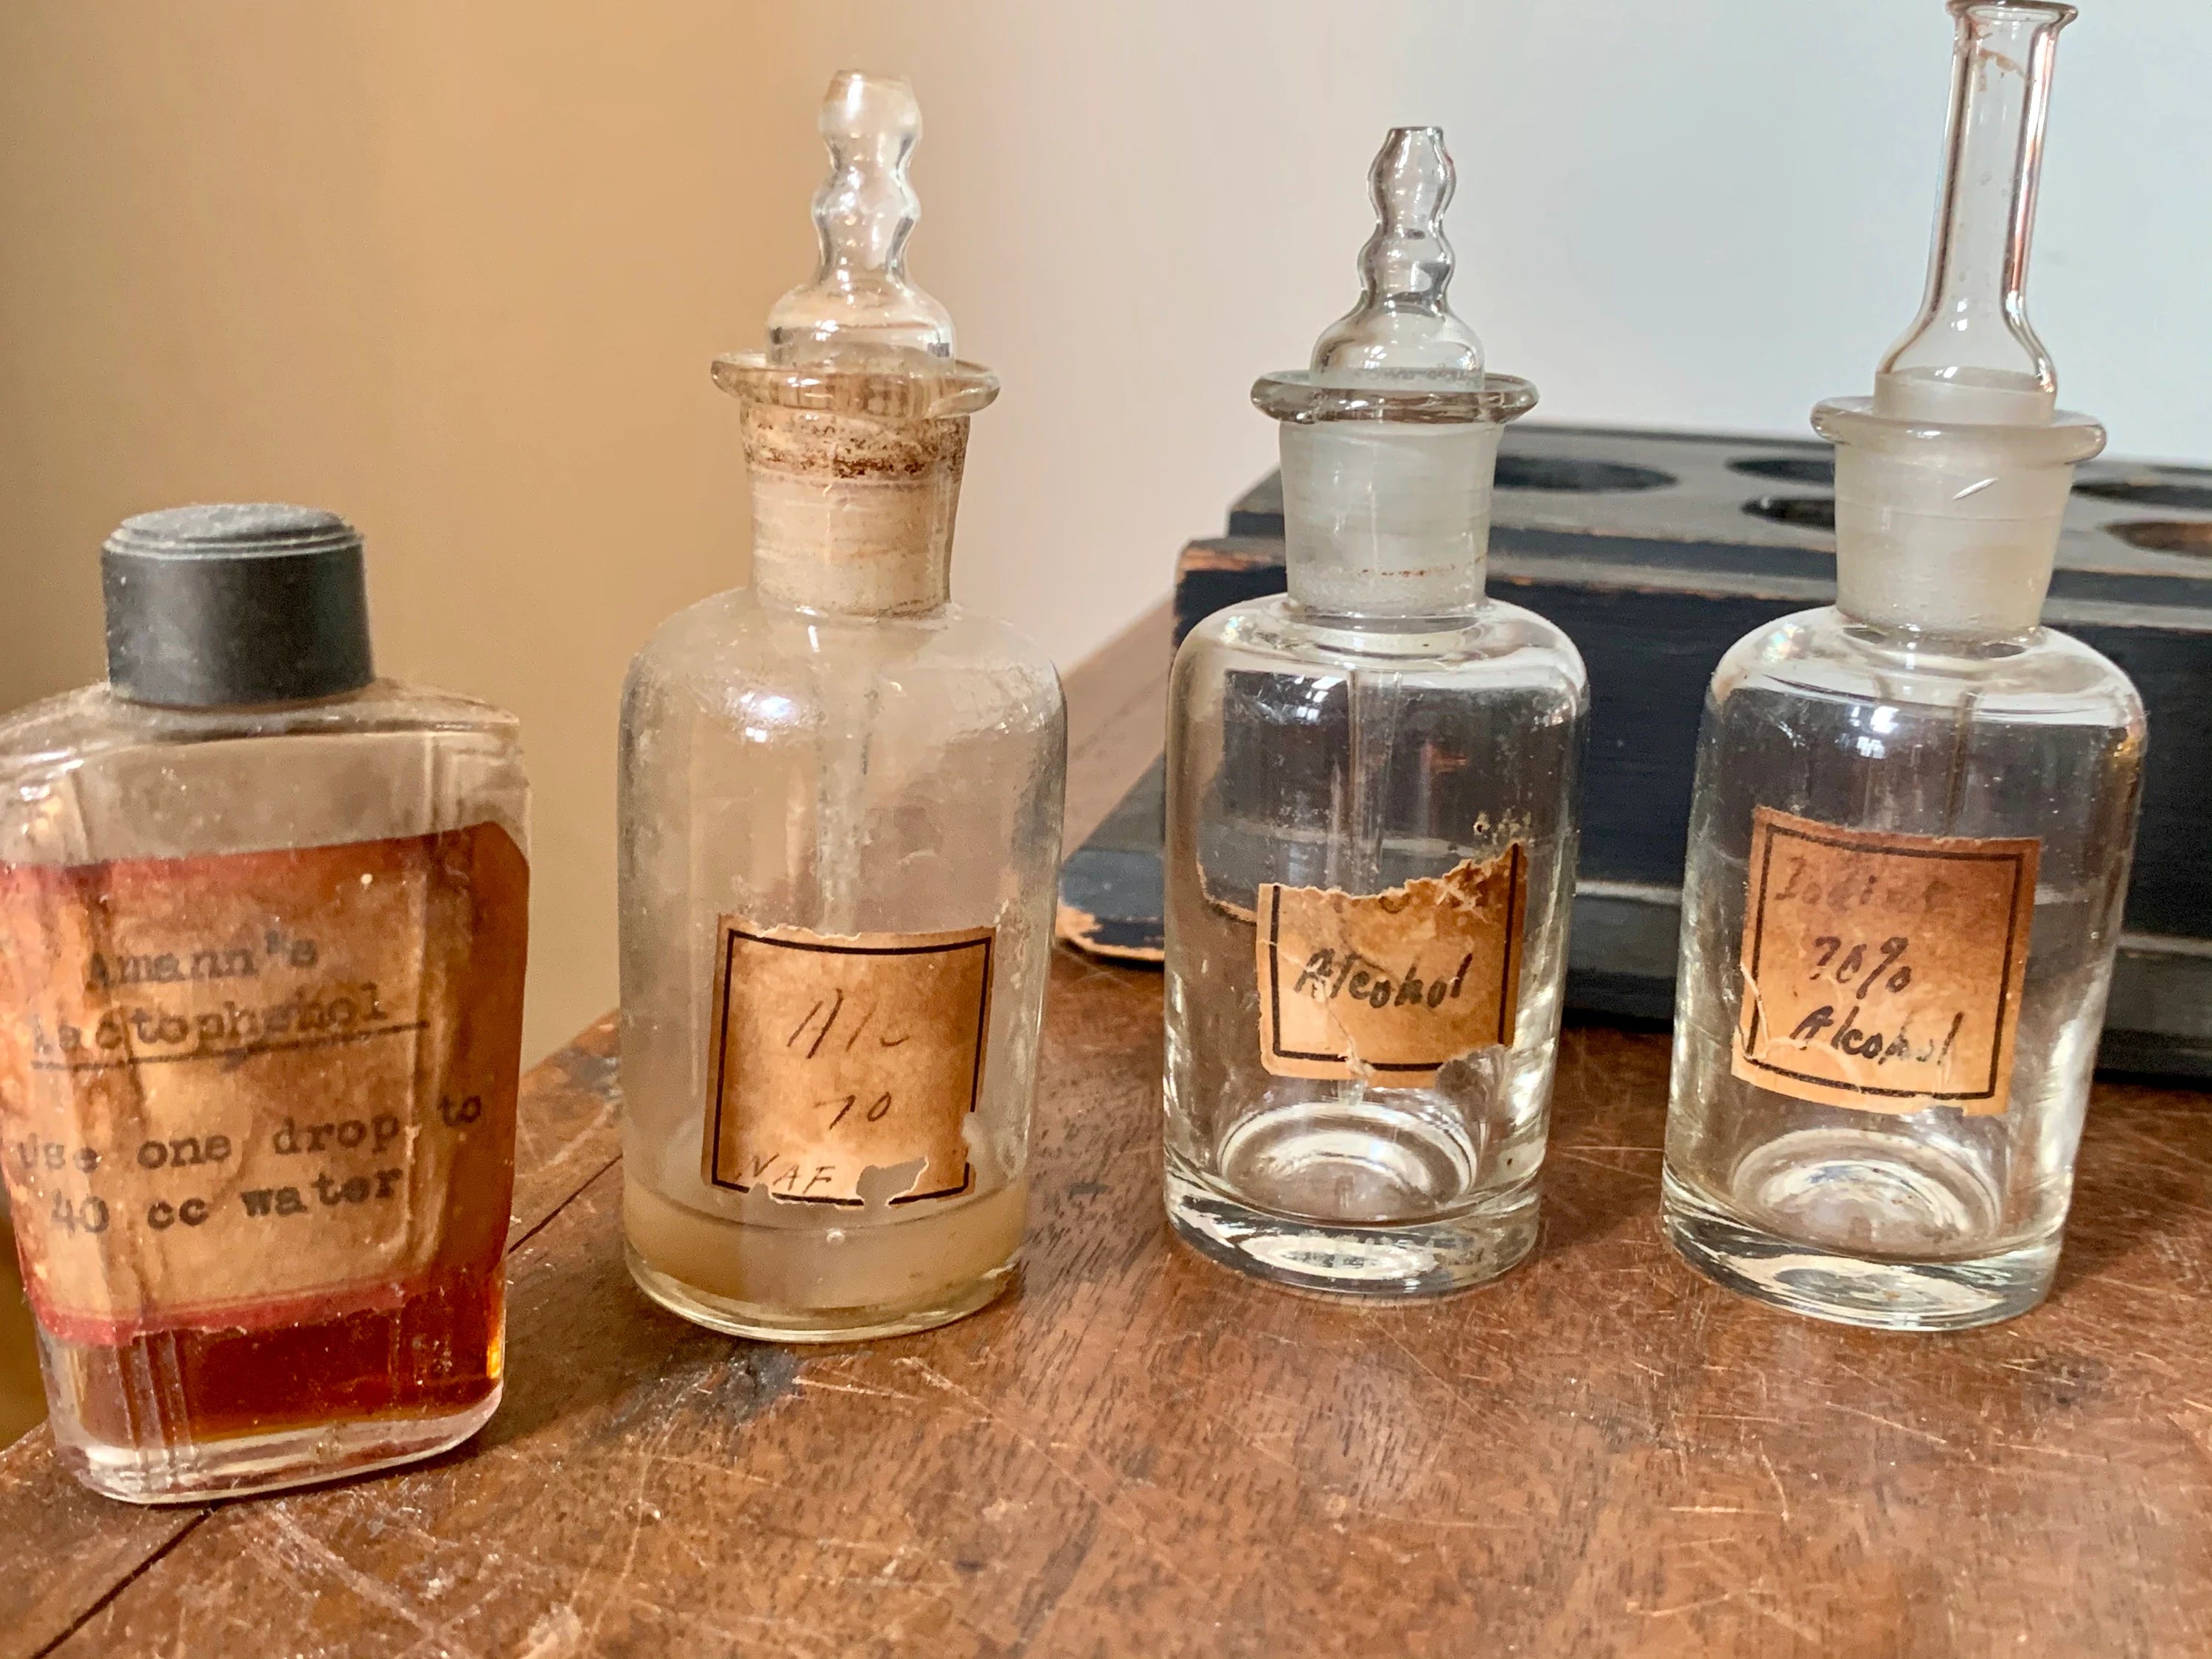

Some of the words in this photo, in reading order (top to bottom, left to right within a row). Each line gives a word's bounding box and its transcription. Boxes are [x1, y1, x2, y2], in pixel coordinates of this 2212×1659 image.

[1293, 947, 1473, 1009] Alcohol
[1809, 936, 1913, 1000] 70%
[1789, 1006, 1965, 1066] Alcohol
[136, 1133, 233, 1171] one
[272, 1111, 400, 1157] drop
[437, 1094, 482, 1128] to
[49, 1190, 110, 1234] 40
[147, 1194, 209, 1230] cc
[240, 1166, 406, 1220] water
